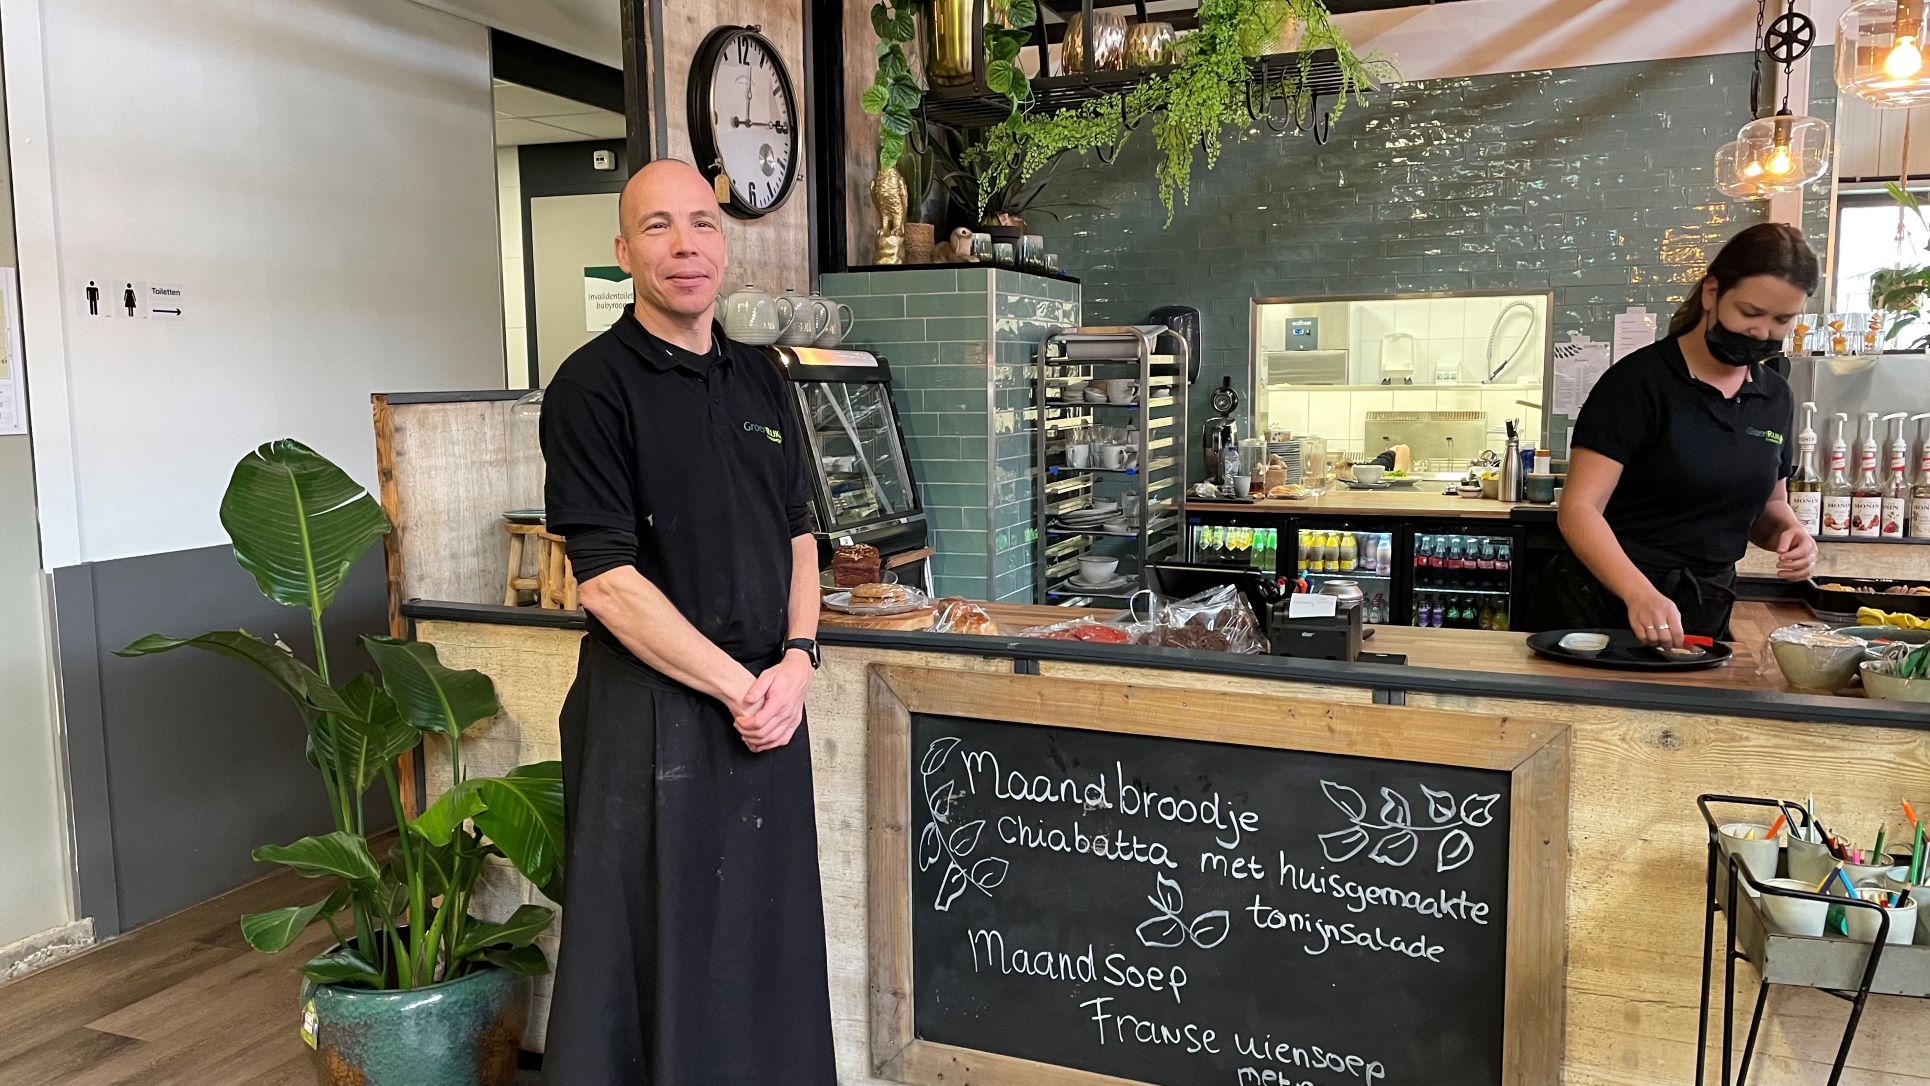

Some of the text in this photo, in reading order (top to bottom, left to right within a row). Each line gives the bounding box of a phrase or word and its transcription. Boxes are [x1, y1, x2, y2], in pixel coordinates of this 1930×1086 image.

[152, 287, 181, 297] Toiletten
[960, 750, 1260, 850] Maandbroodje
[997, 815, 1490, 925] Chiabatta met huisgemaakte
[1079, 996, 1220, 1054] Franse
